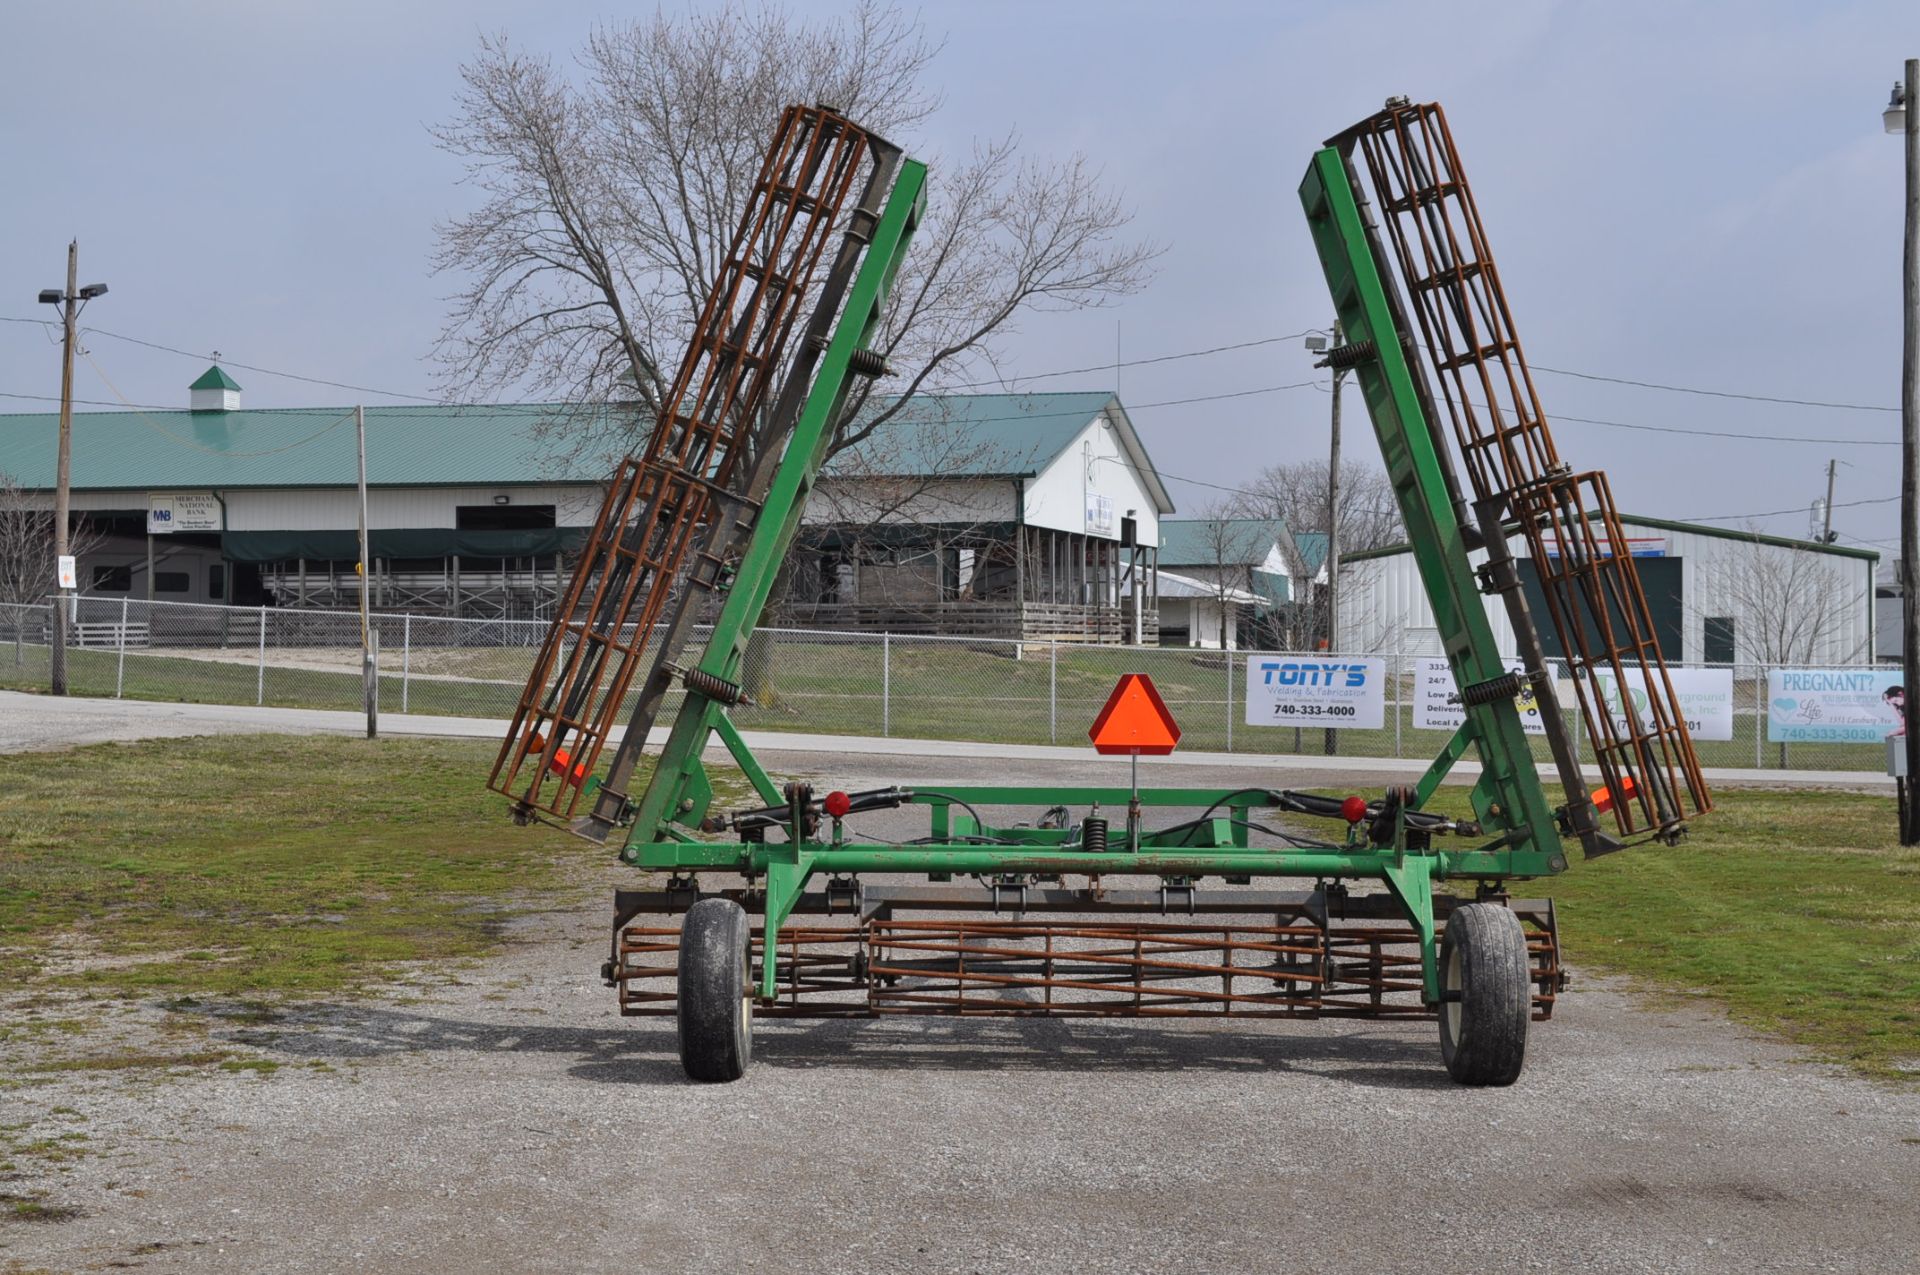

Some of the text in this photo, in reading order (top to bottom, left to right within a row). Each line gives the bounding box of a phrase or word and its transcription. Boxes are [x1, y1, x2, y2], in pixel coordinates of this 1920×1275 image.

[1260, 663, 1367, 687] TONY'S
[1783, 673, 1875, 691] PREGNANT?
[1266, 687, 1367, 697] Welding & Fabrication
[1274, 704, 1355, 716] 740-333-4000
[1699, 704, 1720, 713] Inc.
[1797, 699, 1824, 725] Life
[1781, 728, 1877, 739] 740-333-3030
